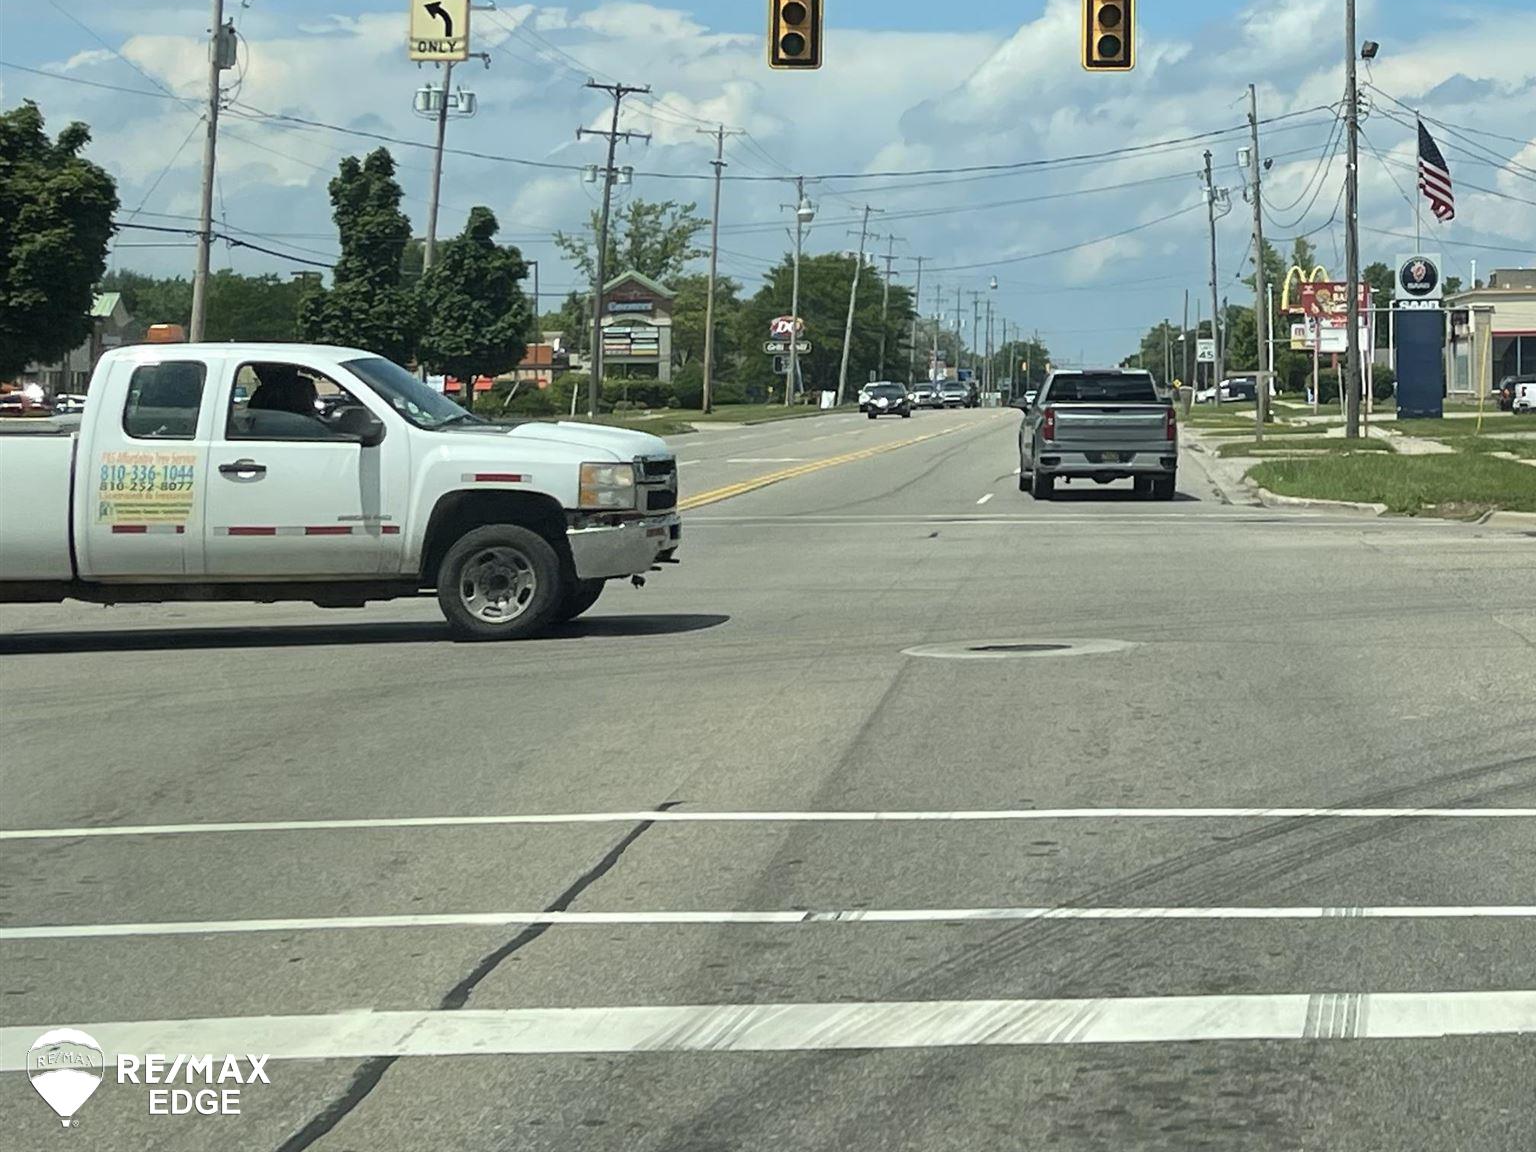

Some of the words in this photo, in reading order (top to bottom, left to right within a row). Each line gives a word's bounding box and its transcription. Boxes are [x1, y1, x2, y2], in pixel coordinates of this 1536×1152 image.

[417, 40, 457, 53] ONLY
[1199, 351, 1214, 359] 45
[100, 464, 194, 481] 810-336-1044
[99, 481, 194, 492] 810-252-8077
